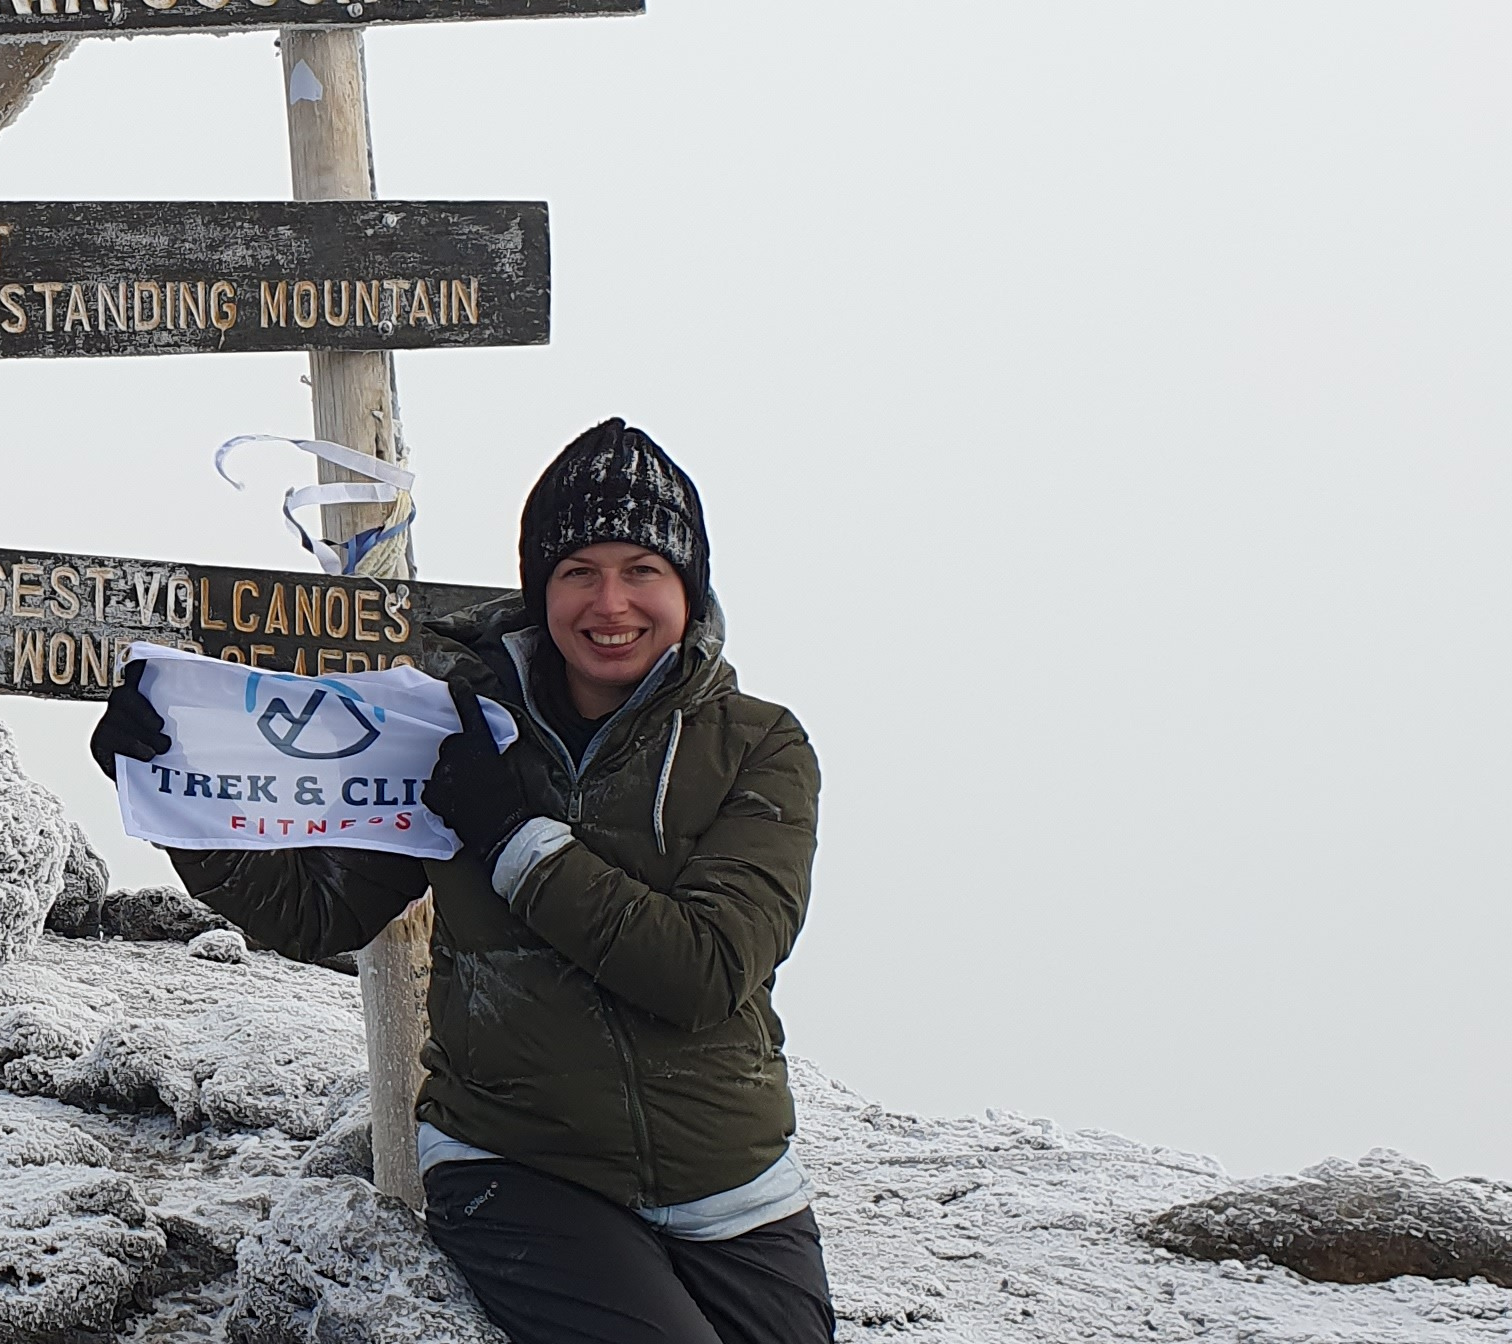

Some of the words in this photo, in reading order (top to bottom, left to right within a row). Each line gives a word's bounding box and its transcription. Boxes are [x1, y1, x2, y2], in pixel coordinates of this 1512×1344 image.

[0, 280, 237, 333] STANDING
[259, 278, 479, 329] MOUNTAIN
[134, 572, 413, 644] VOLCANOES
[151, 765, 278, 803] TREK
[294, 776, 325, 805] &
[341, 777, 429, 806] CLI
